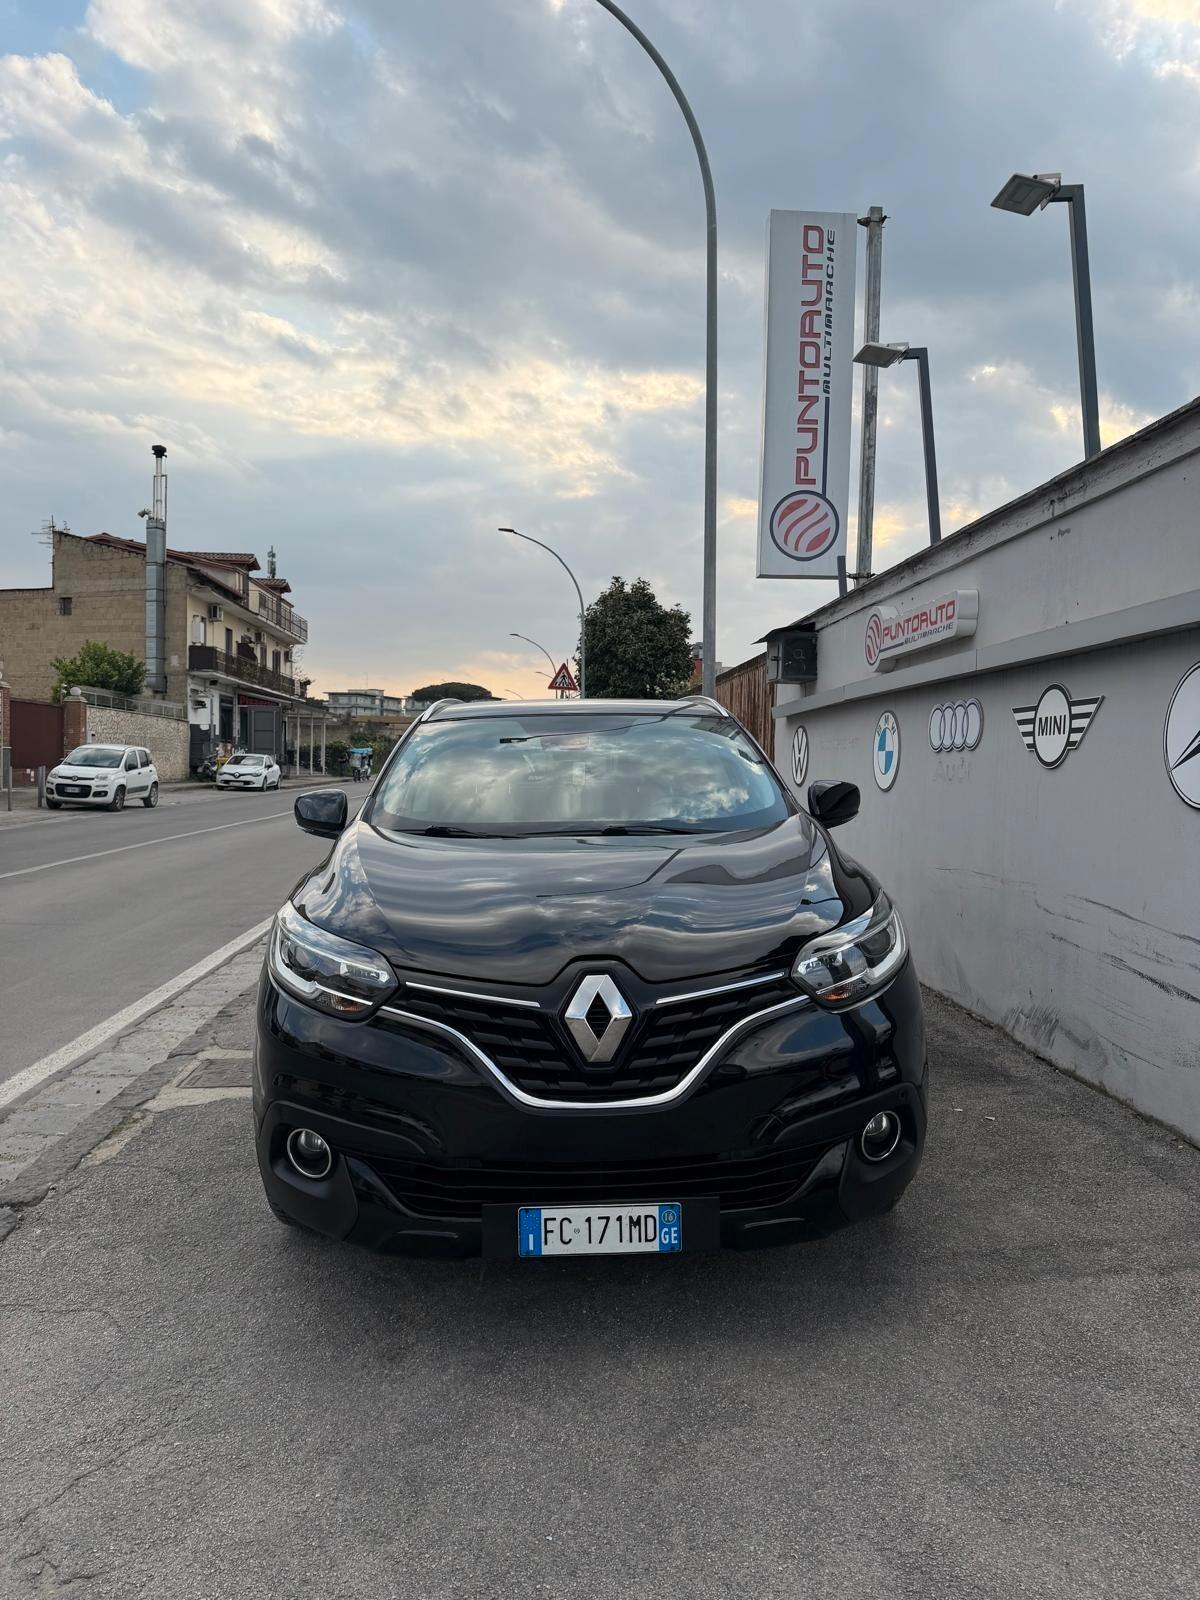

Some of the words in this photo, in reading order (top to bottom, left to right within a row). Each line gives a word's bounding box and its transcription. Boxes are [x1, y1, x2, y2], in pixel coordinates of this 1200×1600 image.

[823, 229, 837, 395] MULTIMARCHE
[795, 224, 825, 486] PUNTOAUTO
[881, 599, 955, 645] PUNTOAUTO
[1037, 714, 1067, 737] MINI
[543, 1217, 573, 1246] FC
[661, 1227, 679, 1244] GE
